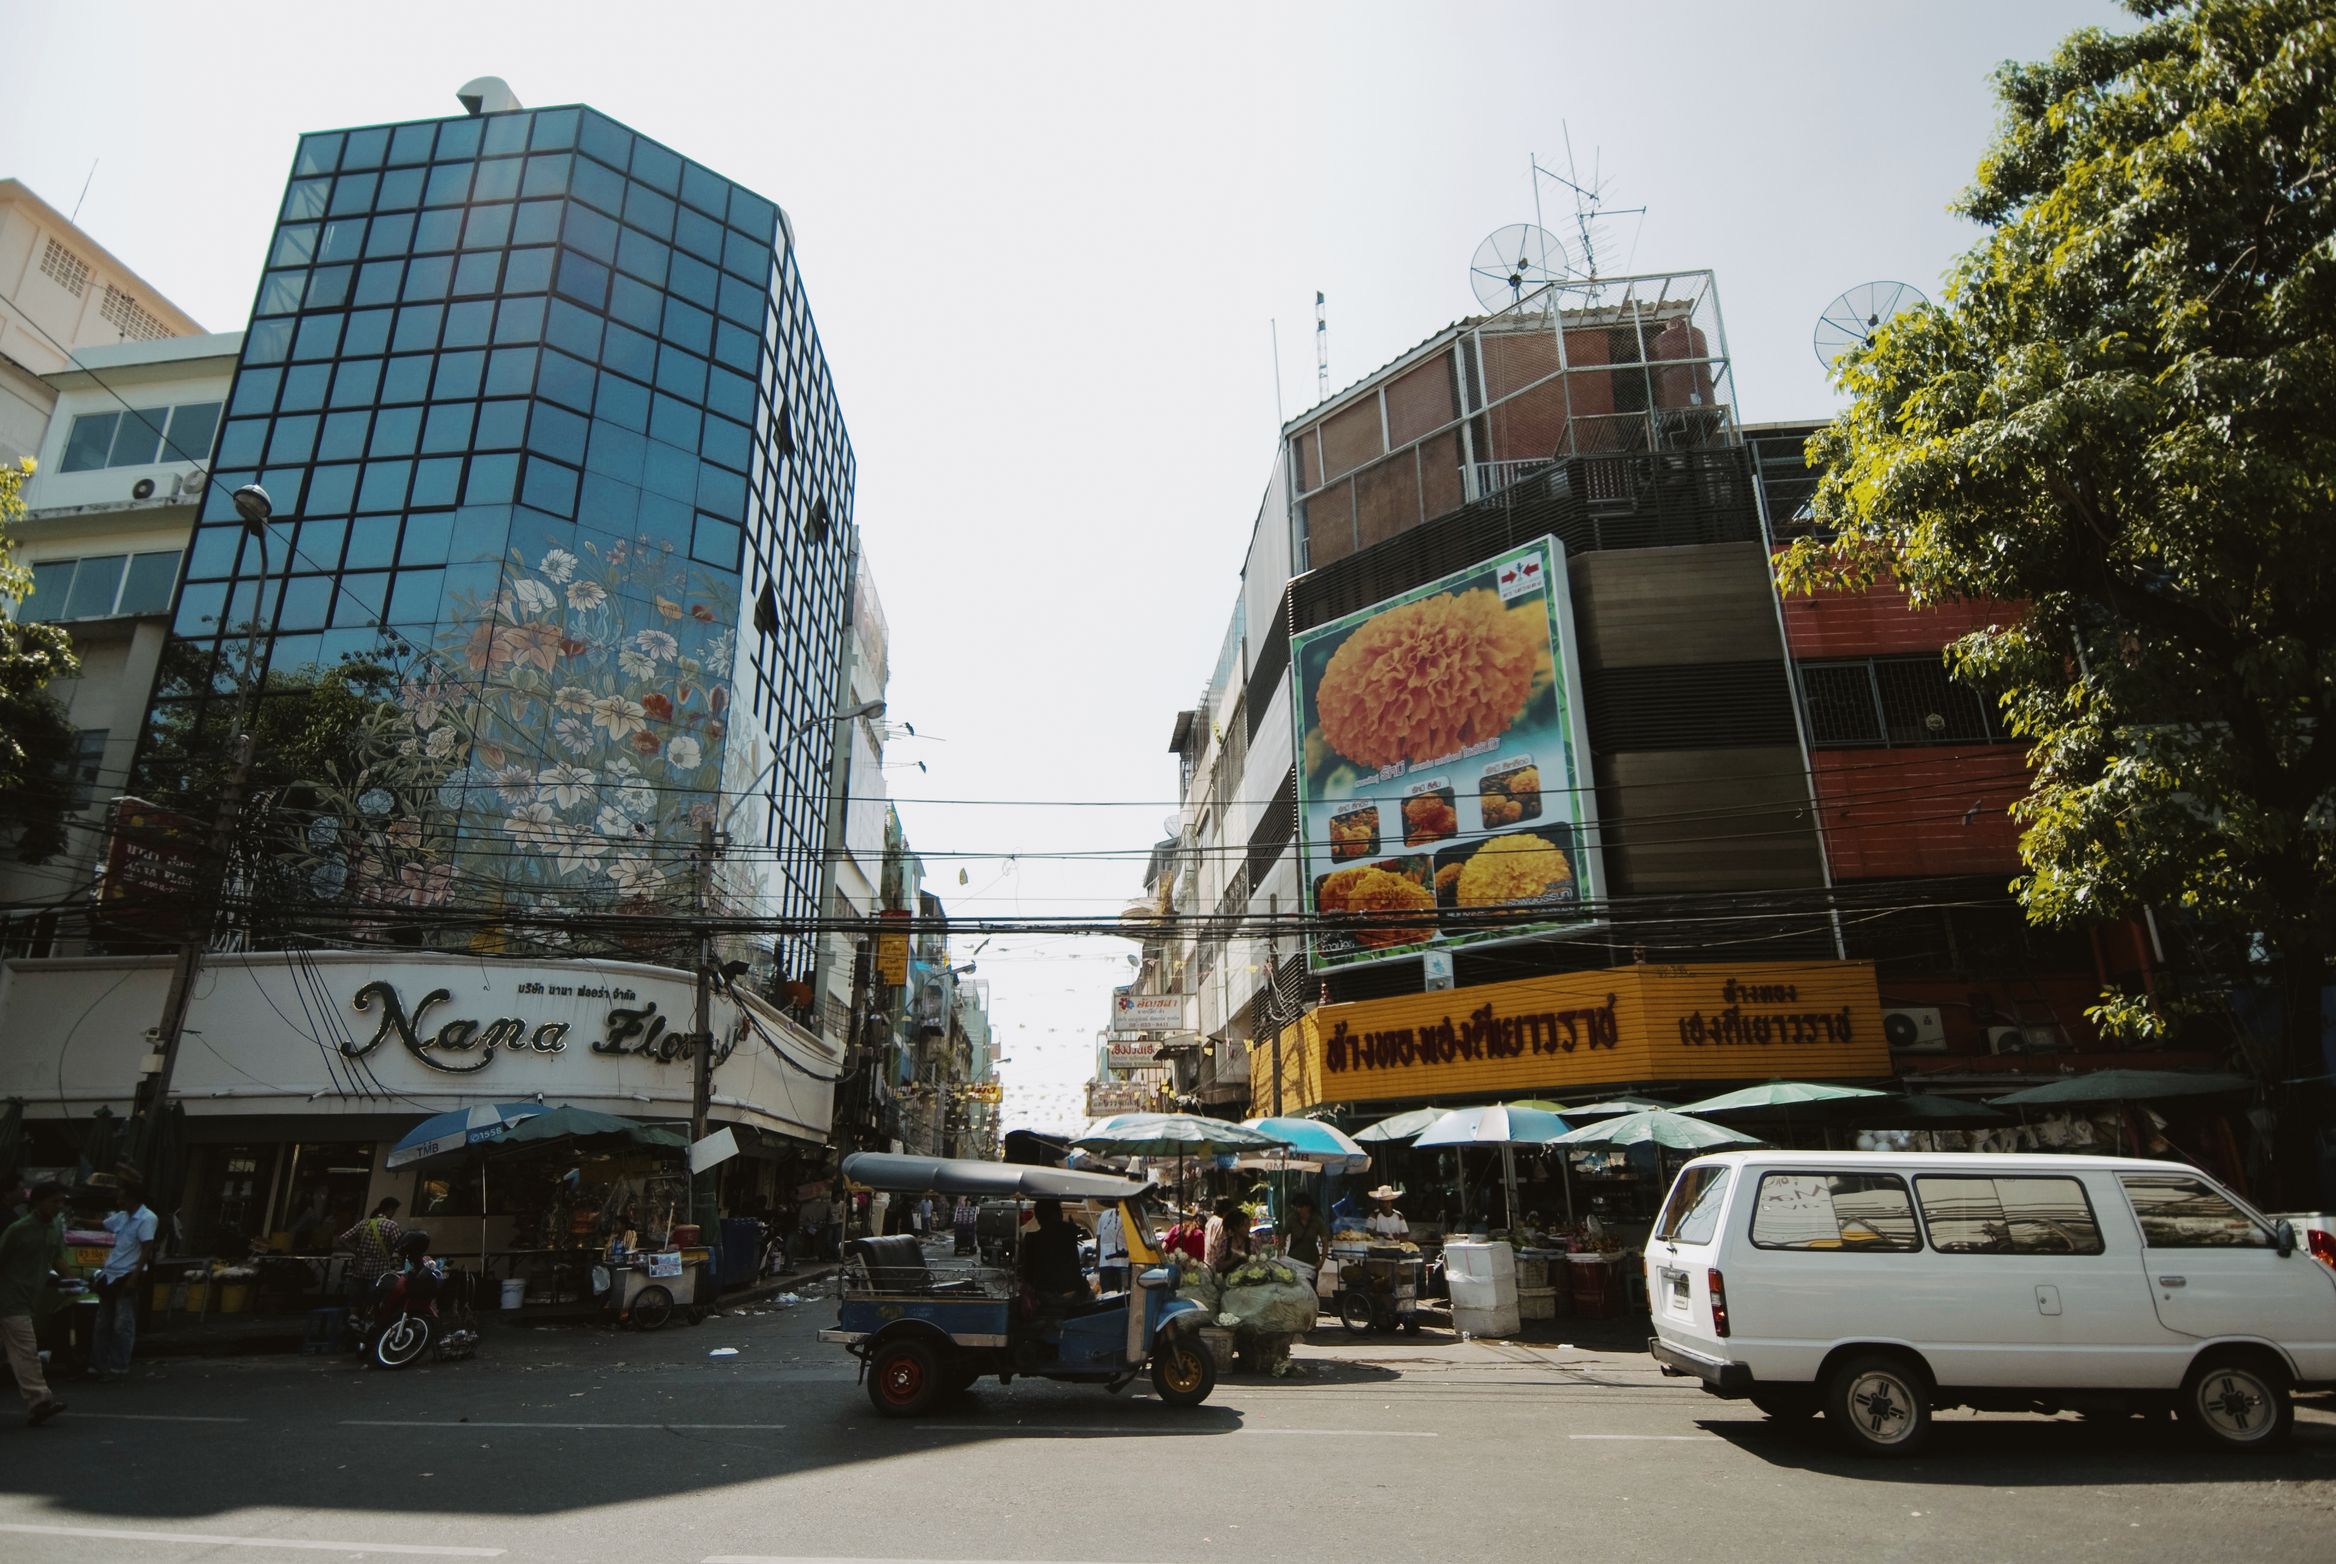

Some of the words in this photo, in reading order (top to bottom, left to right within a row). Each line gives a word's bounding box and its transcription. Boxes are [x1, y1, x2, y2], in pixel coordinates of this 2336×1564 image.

[518, 983, 544, 995] บริษัท
[548, 985, 573, 997] นานา
[612, 987, 636, 1001] จำกัด
[340, 981, 572, 1073] Nana
[479, 1127, 503, 1140] 1558
[417, 1143, 439, 1158] TMB
